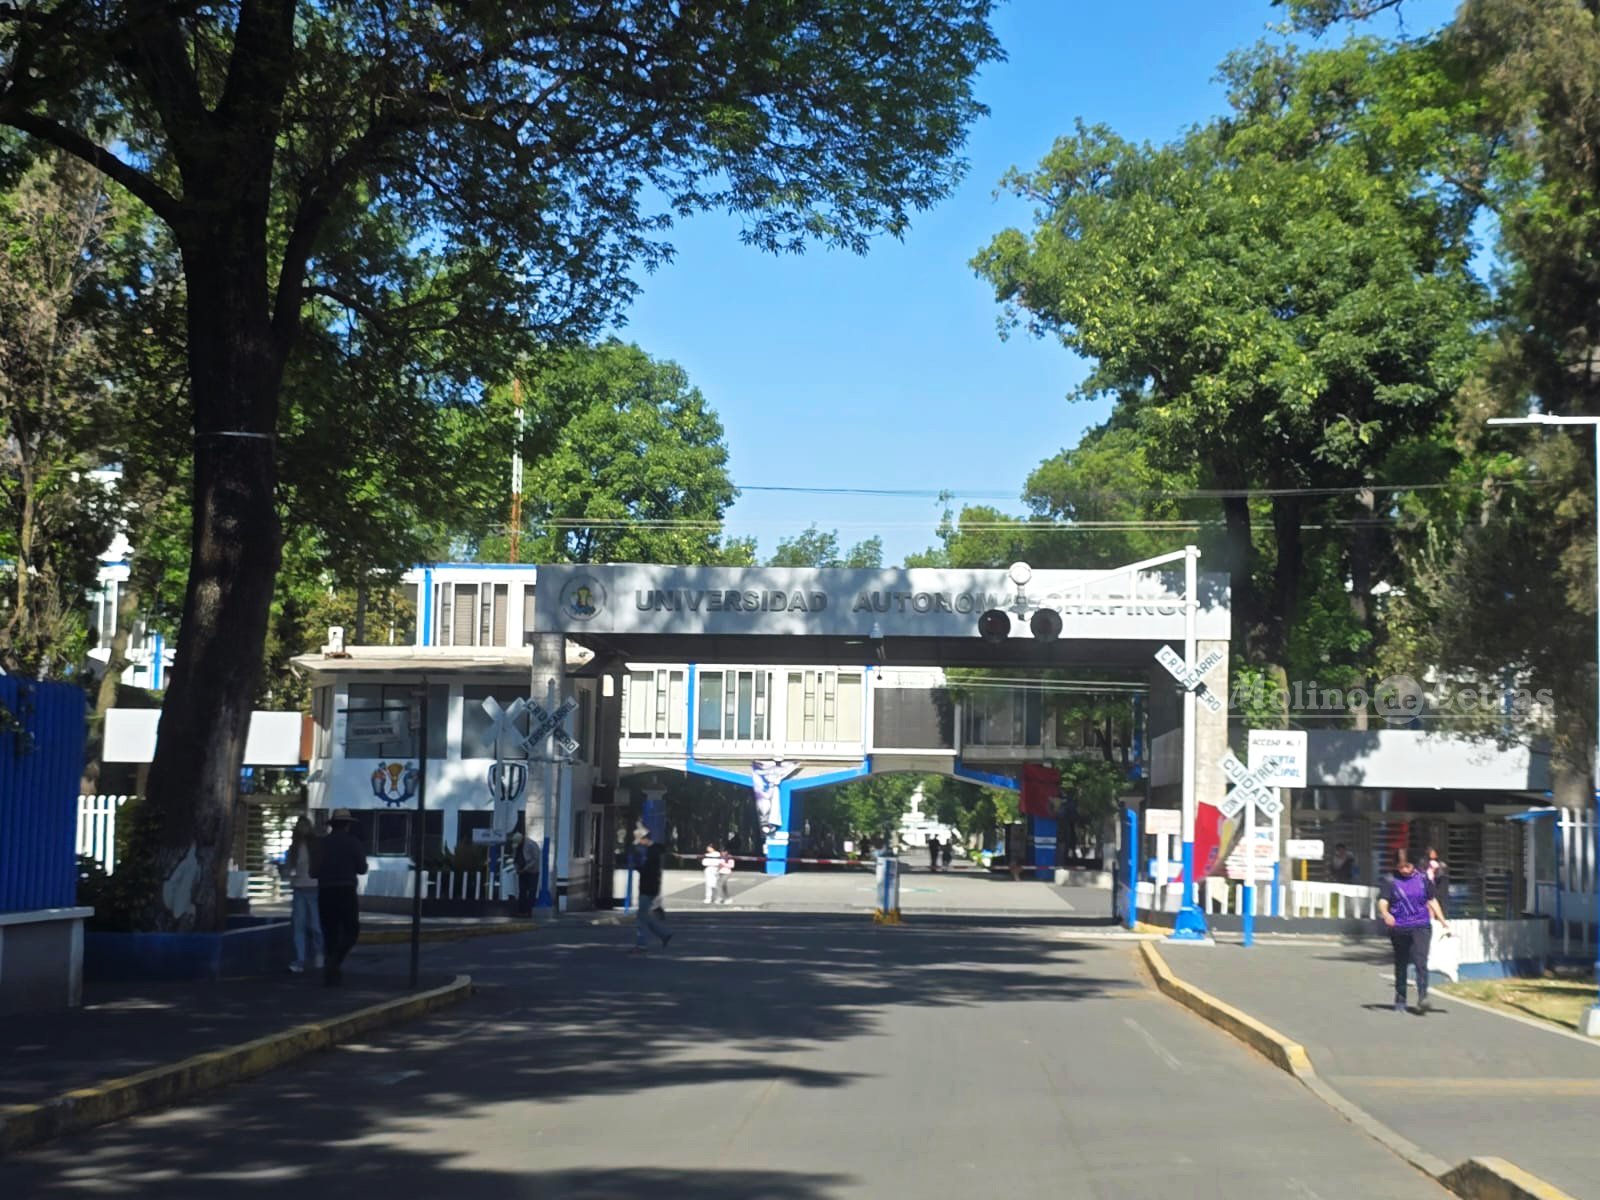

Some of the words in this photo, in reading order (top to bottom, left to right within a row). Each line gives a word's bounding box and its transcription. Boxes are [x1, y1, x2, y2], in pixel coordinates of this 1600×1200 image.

[635, 590, 827, 613] UNIVERSIDAD
[1160, 651, 1221, 711] CRUERO
[1223, 758, 1278, 814] CUIDADO
